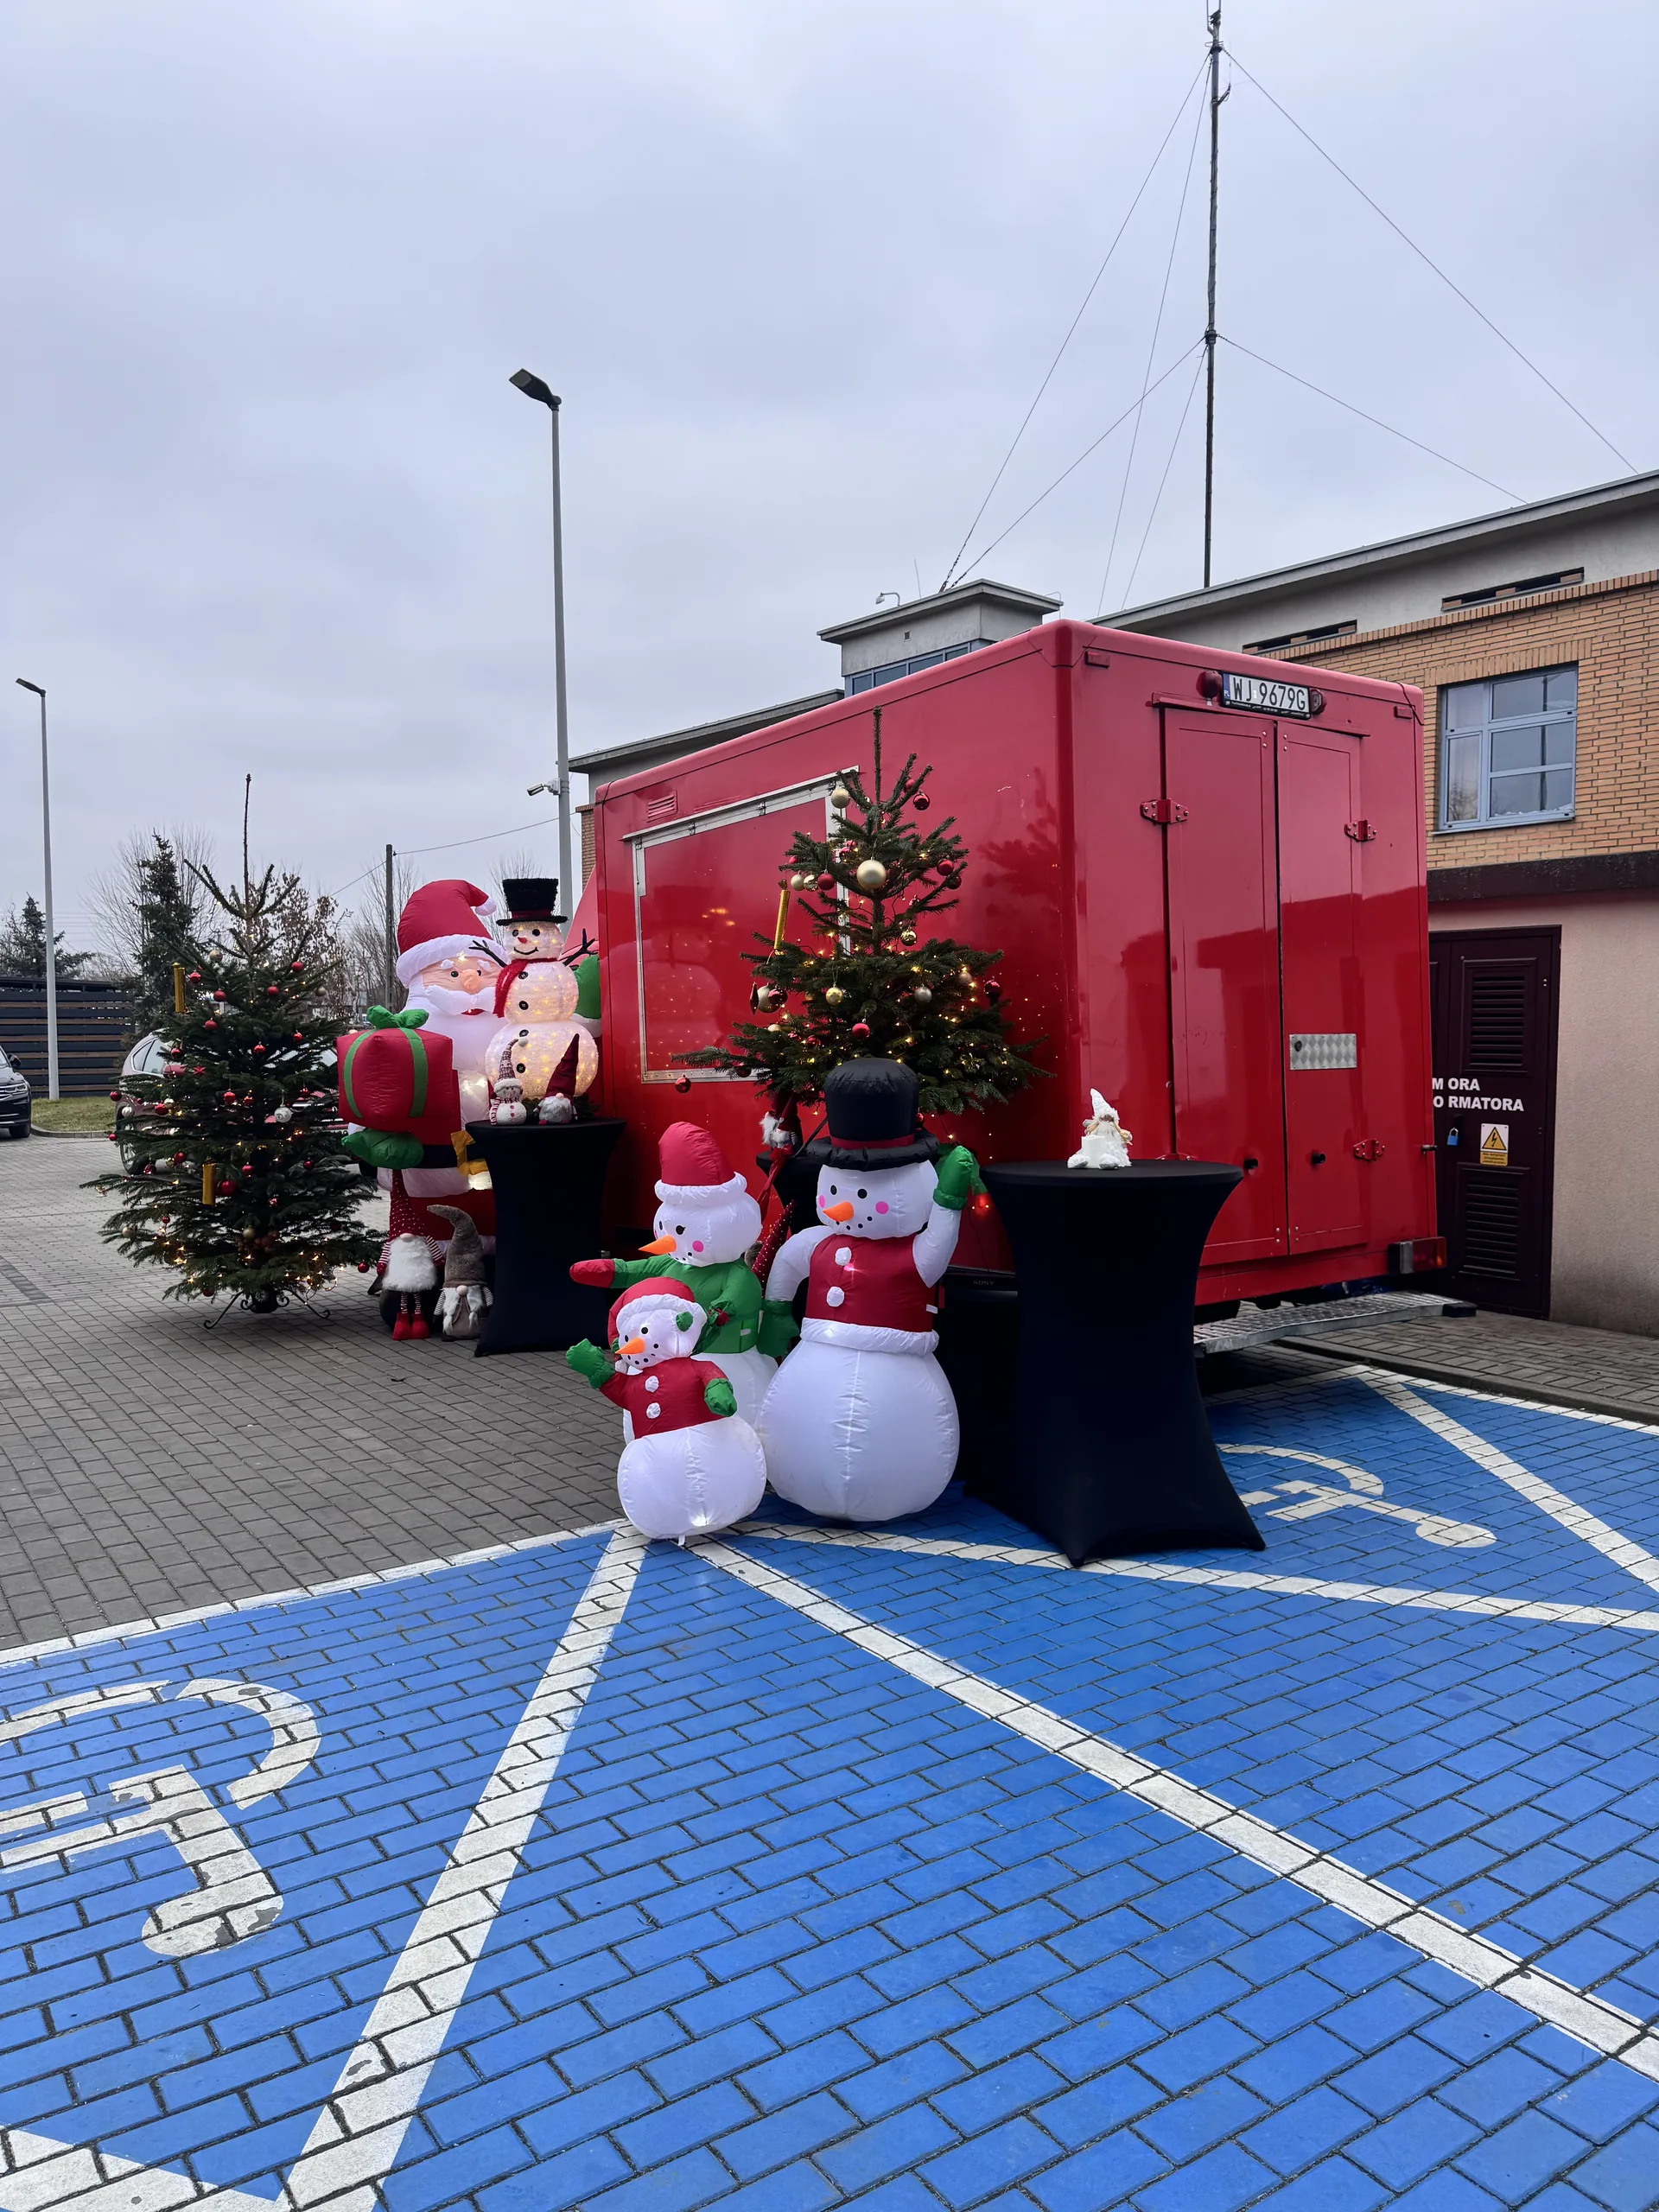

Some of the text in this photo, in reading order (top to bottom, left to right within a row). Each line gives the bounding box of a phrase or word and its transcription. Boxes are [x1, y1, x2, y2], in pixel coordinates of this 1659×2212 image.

[1233, 677, 1306, 710] WJ 9679G
[1447, 1077, 1480, 1090] ORA
[1448, 1096, 1524, 1111] RMATORA
